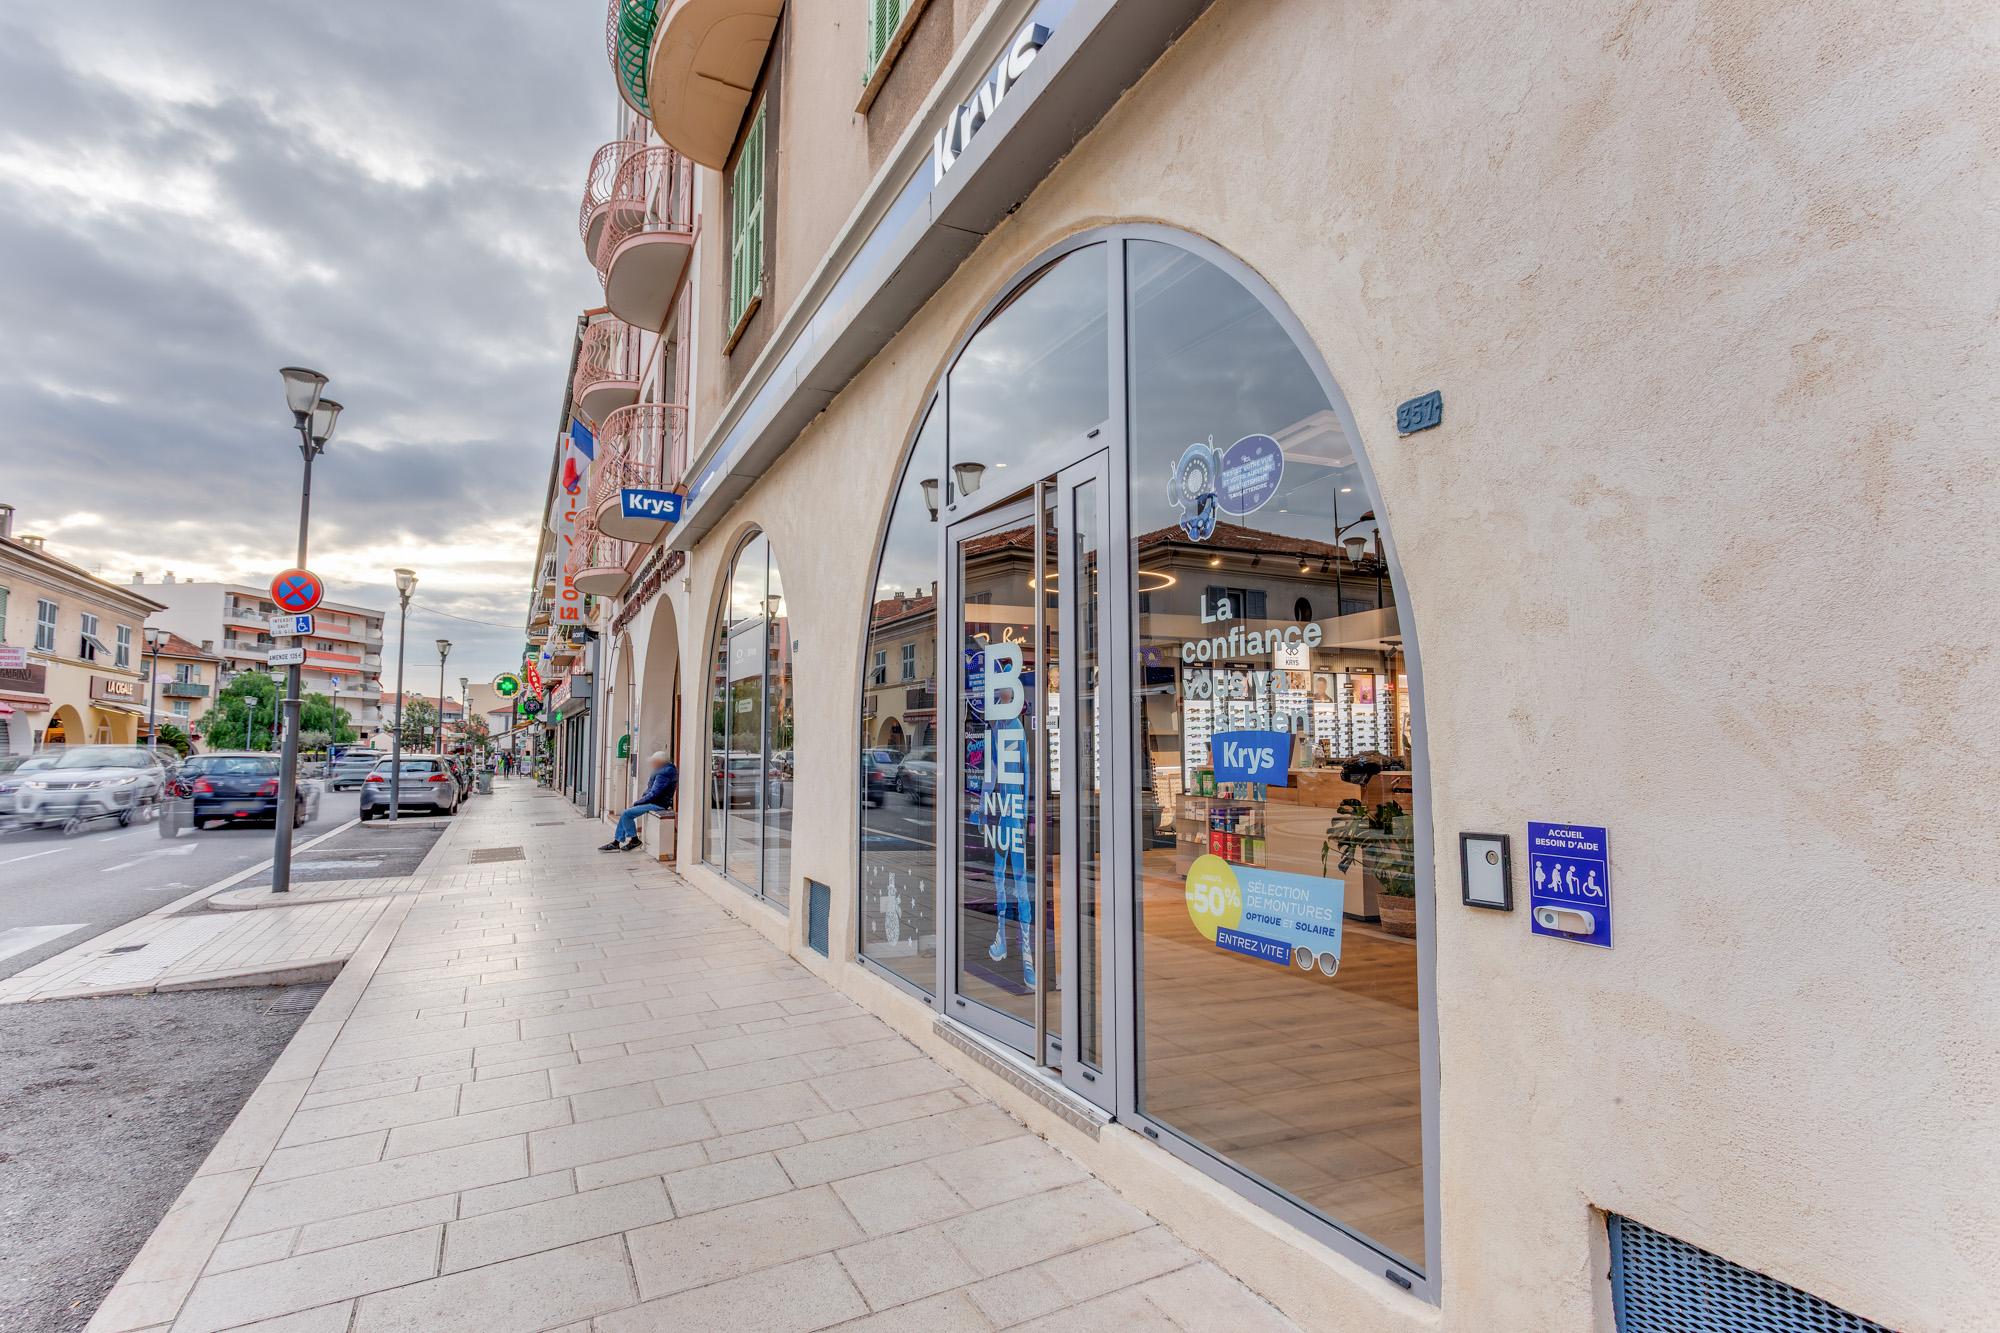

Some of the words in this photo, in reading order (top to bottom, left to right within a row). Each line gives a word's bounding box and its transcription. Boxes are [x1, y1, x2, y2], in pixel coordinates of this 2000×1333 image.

[1401, 398, 1435, 429] 357
[629, 493, 674, 515] Krys
[1200, 594, 1233, 625] La
[1182, 622, 1322, 664] confiance
[107, 680, 115, 693] LA
[116, 682, 134, 695] CIGALE
[530, 665, 541, 692] TABAC
[1182, 671, 1246, 701] vous
[1252, 669, 1289, 695] va
[1244, 704, 1310, 734] bien
[1223, 741, 1275, 775] Krys
[984, 791, 1024, 819] NVE
[984, 823, 1024, 853] NUE
[1535, 838, 1565, 849] BESOIN
[1548, 829, 1584, 840] ACCUEIL
[1186, 883, 1241, 917] -50%
[1247, 880, 1310, 902] SÉLECTION
[1247, 895, 1261, 909] DE
[1263, 897, 1333, 921] MONTURES
[1246, 912, 1282, 927] OPTIQUE
[1283, 918, 1294, 929] ET
[1295, 922, 1336, 938] SOLAIRE
[1218, 932, 1258, 952] ENTREZ
[1260, 942, 1283, 959] VITE
